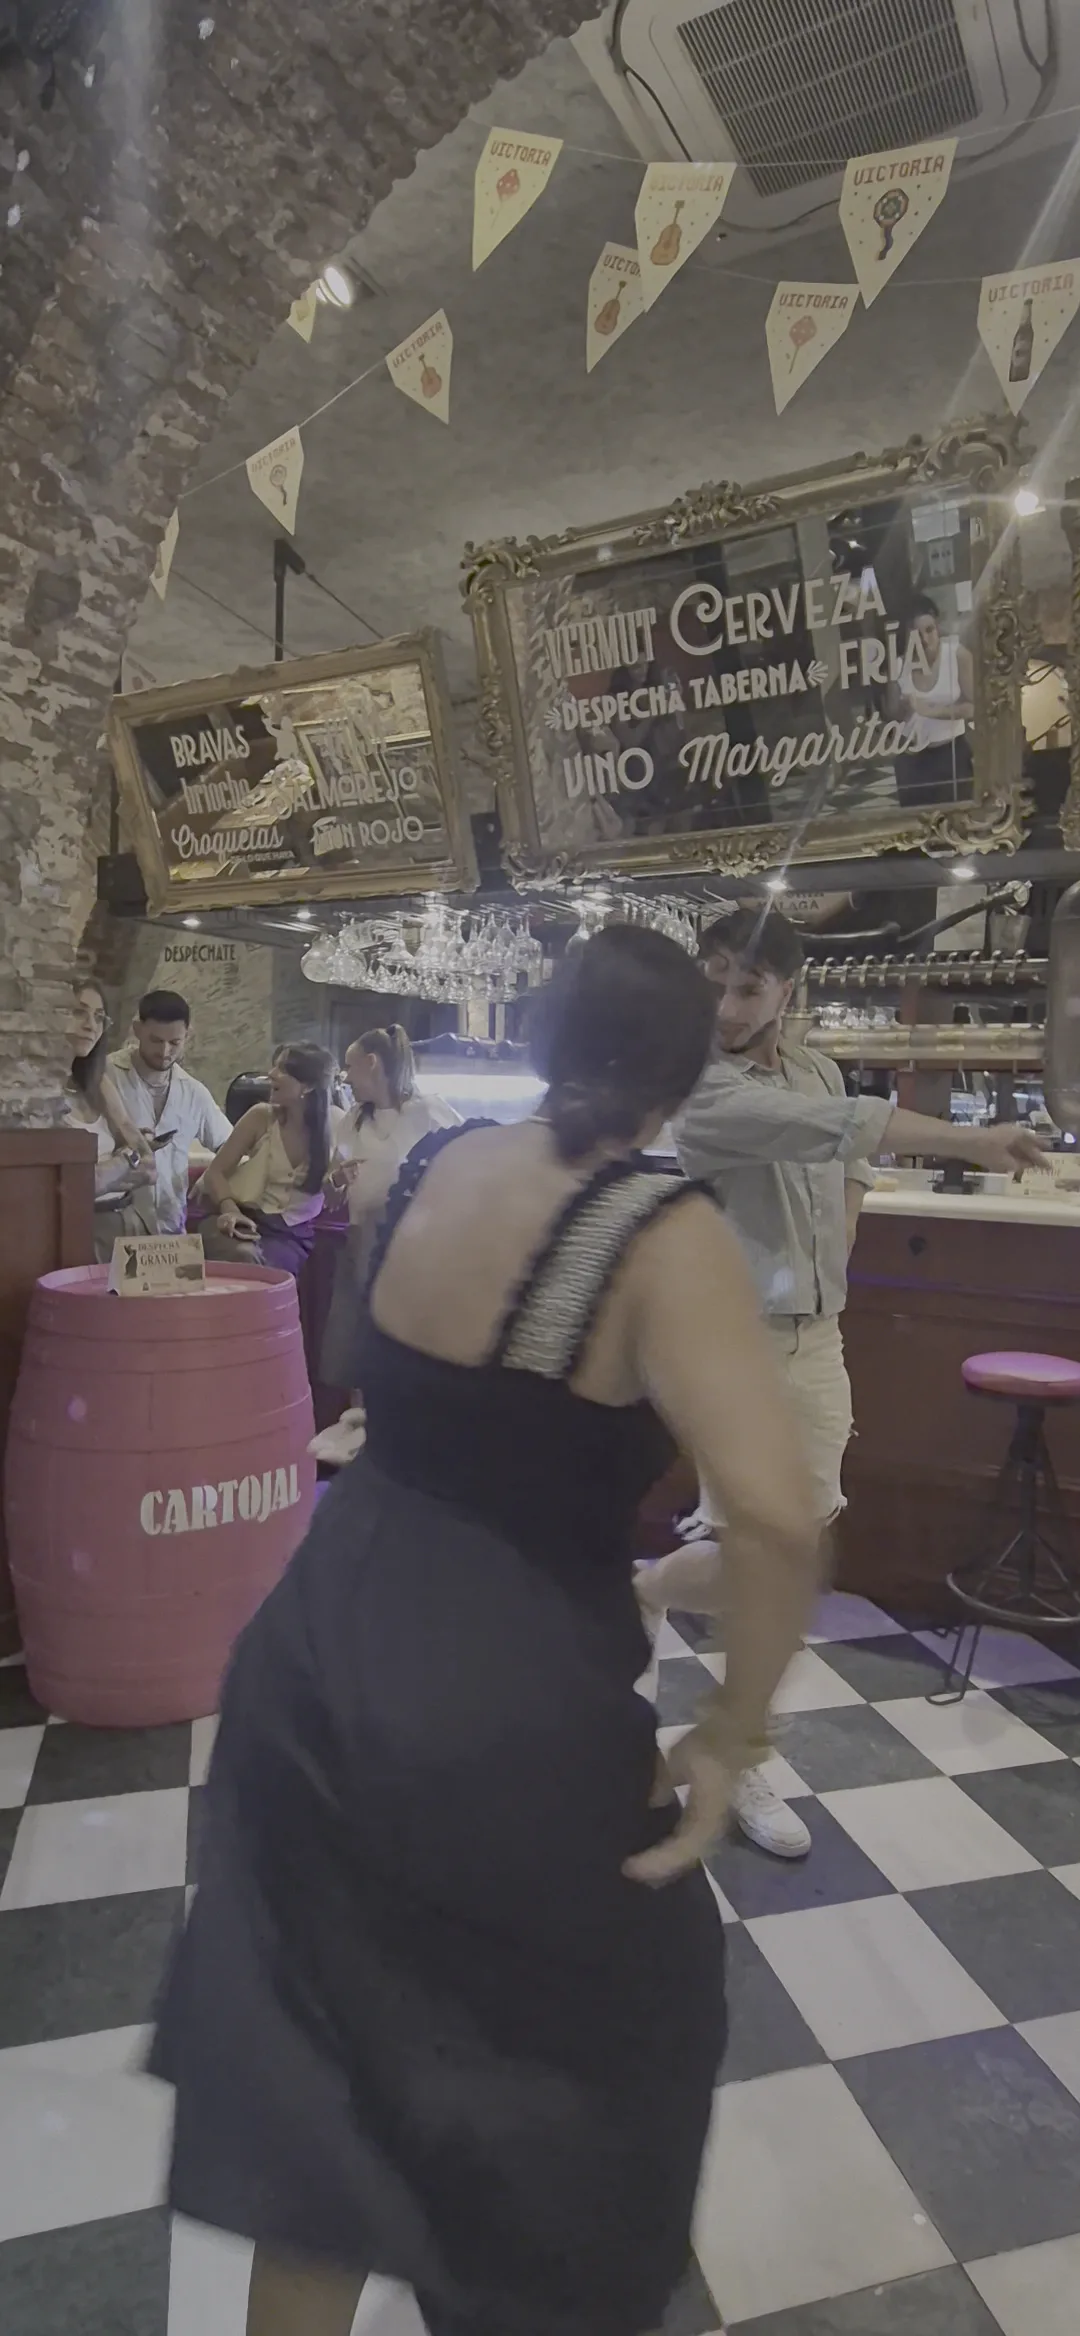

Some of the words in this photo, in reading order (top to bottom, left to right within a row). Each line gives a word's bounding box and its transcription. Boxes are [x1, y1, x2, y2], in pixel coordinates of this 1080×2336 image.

[490, 140, 551, 167] VICTORIA
[855, 155, 945, 186] VICTORIA
[649, 174, 724, 192] VICTORIA
[779, 293, 849, 309] VICTORIA
[988, 273, 1075, 303] VICTORIA
[393, 321, 443, 369] VICTORIA
[251, 438, 297, 473] VICTORIA
[543, 607, 656, 680] VERMUT
[670, 567, 887, 655] CERVEZA
[839, 621, 933, 690] FRÍA
[689, 660, 807, 709] TABERNA
[170, 725, 250, 768] BRAVAS
[563, 747, 654, 799] VINO
[679, 711, 932, 789] Margaritas
[171, 824, 284, 863] Croquetas
[358, 815, 424, 847] ROJO
[164, 941, 237, 962] DESPÉCHATE
[140, 1464, 301, 1536] CARTOJAL
